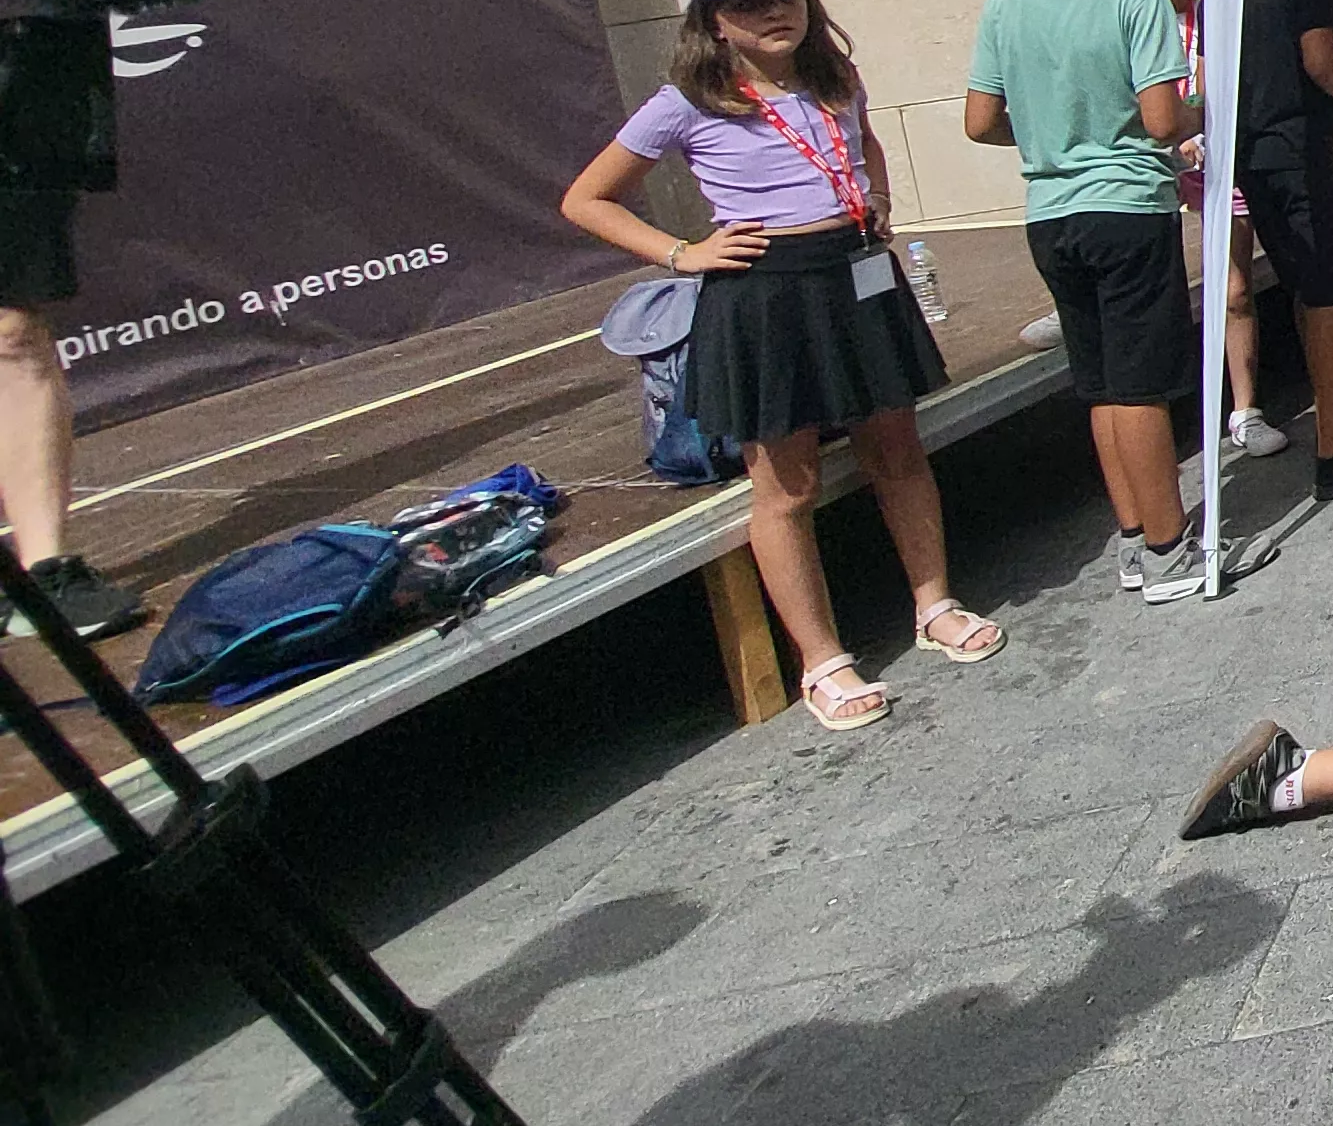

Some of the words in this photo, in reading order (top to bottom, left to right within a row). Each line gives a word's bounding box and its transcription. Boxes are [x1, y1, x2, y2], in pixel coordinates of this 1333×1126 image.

[55, 298, 226, 370] pirando
[239, 289, 263, 316] a
[271, 240, 450, 312] personas
